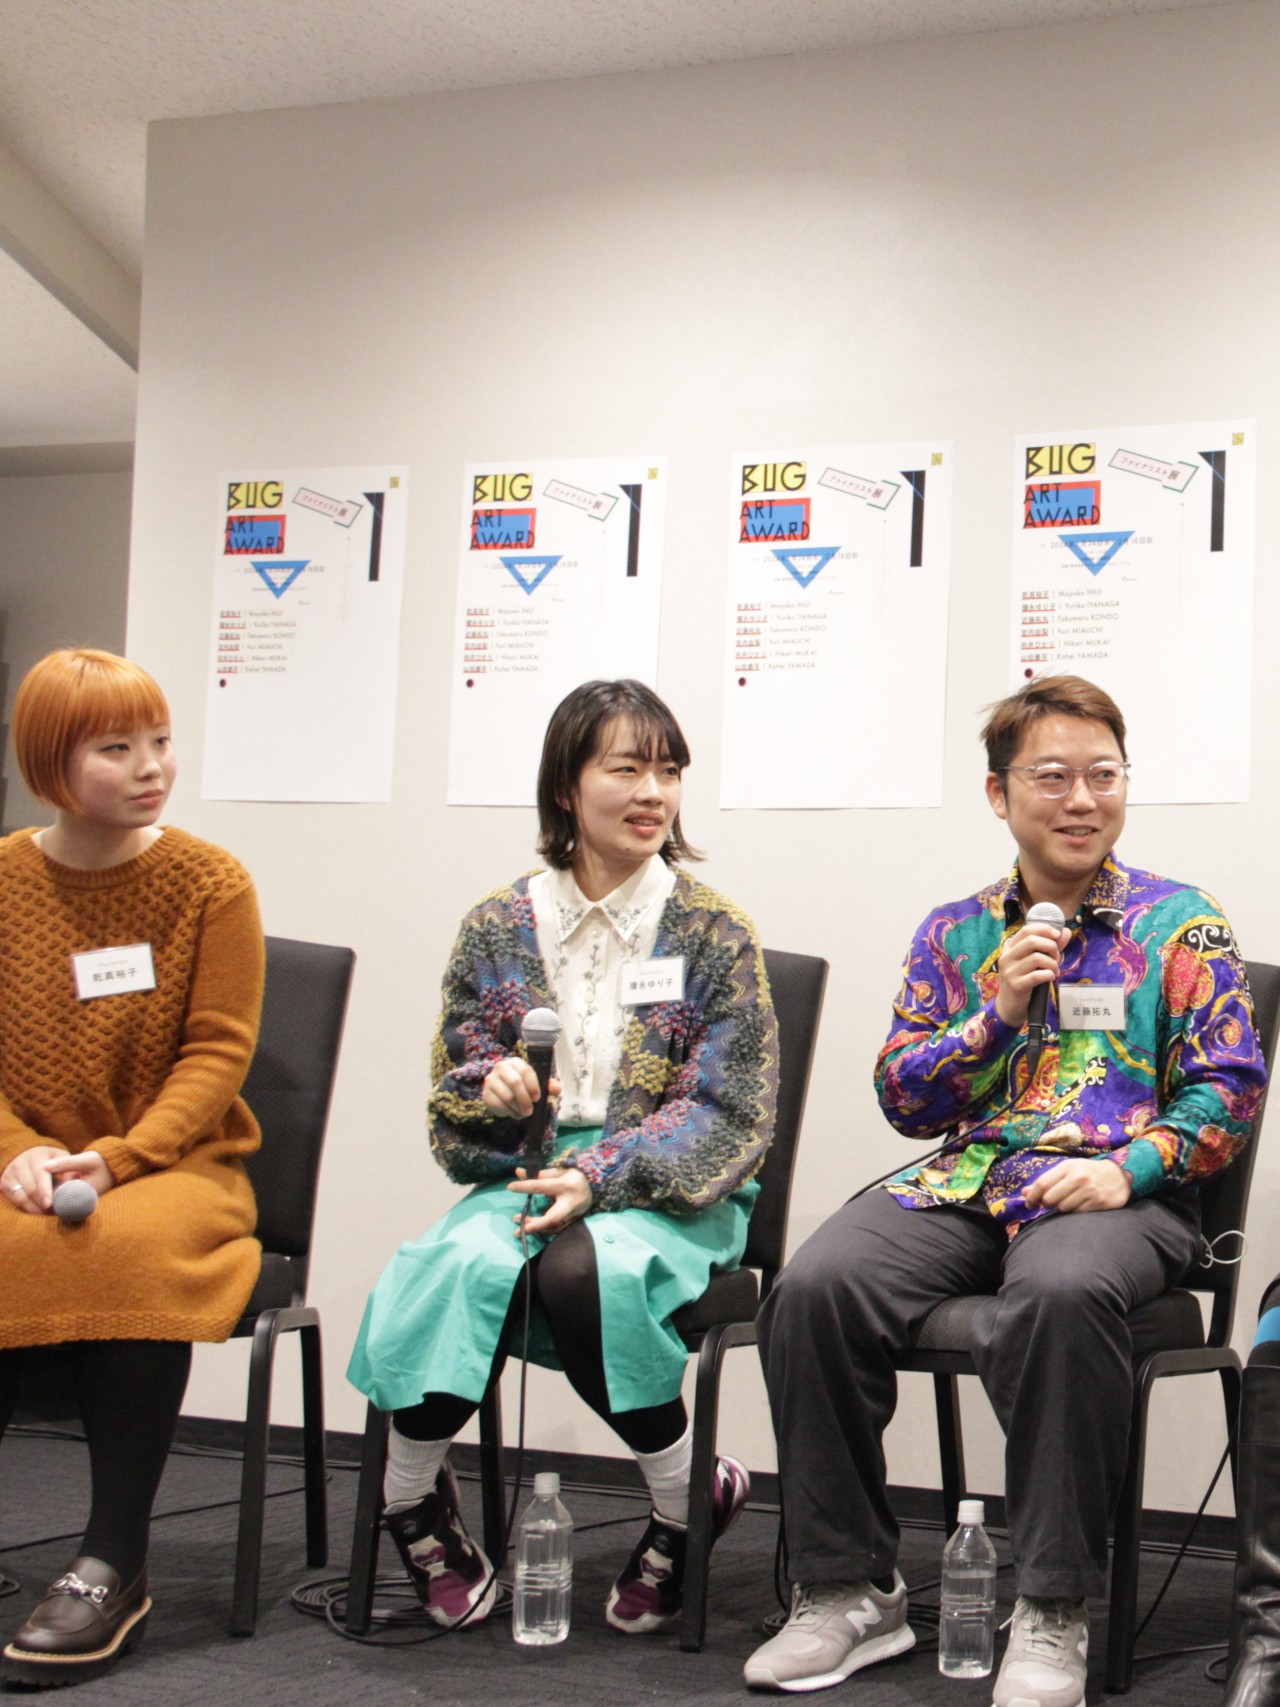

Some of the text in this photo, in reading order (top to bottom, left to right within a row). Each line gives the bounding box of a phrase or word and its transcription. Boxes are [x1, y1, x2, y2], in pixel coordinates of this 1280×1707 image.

[1025, 442, 1097, 481] BUG
[473, 473, 534, 507] BUG
[741, 461, 807, 497] BUG
[226, 481, 284, 513] BUG
[1023, 483, 1063, 505] ART
[470, 509, 505, 528] ART
[739, 499, 776, 520] ART
[1022, 505, 1101, 530] AWARD
[224, 516, 256, 534] ART
[738, 521, 811, 544] AWARD
[223, 536, 285, 556] AWARD
[469, 530, 536, 551] AWARD
